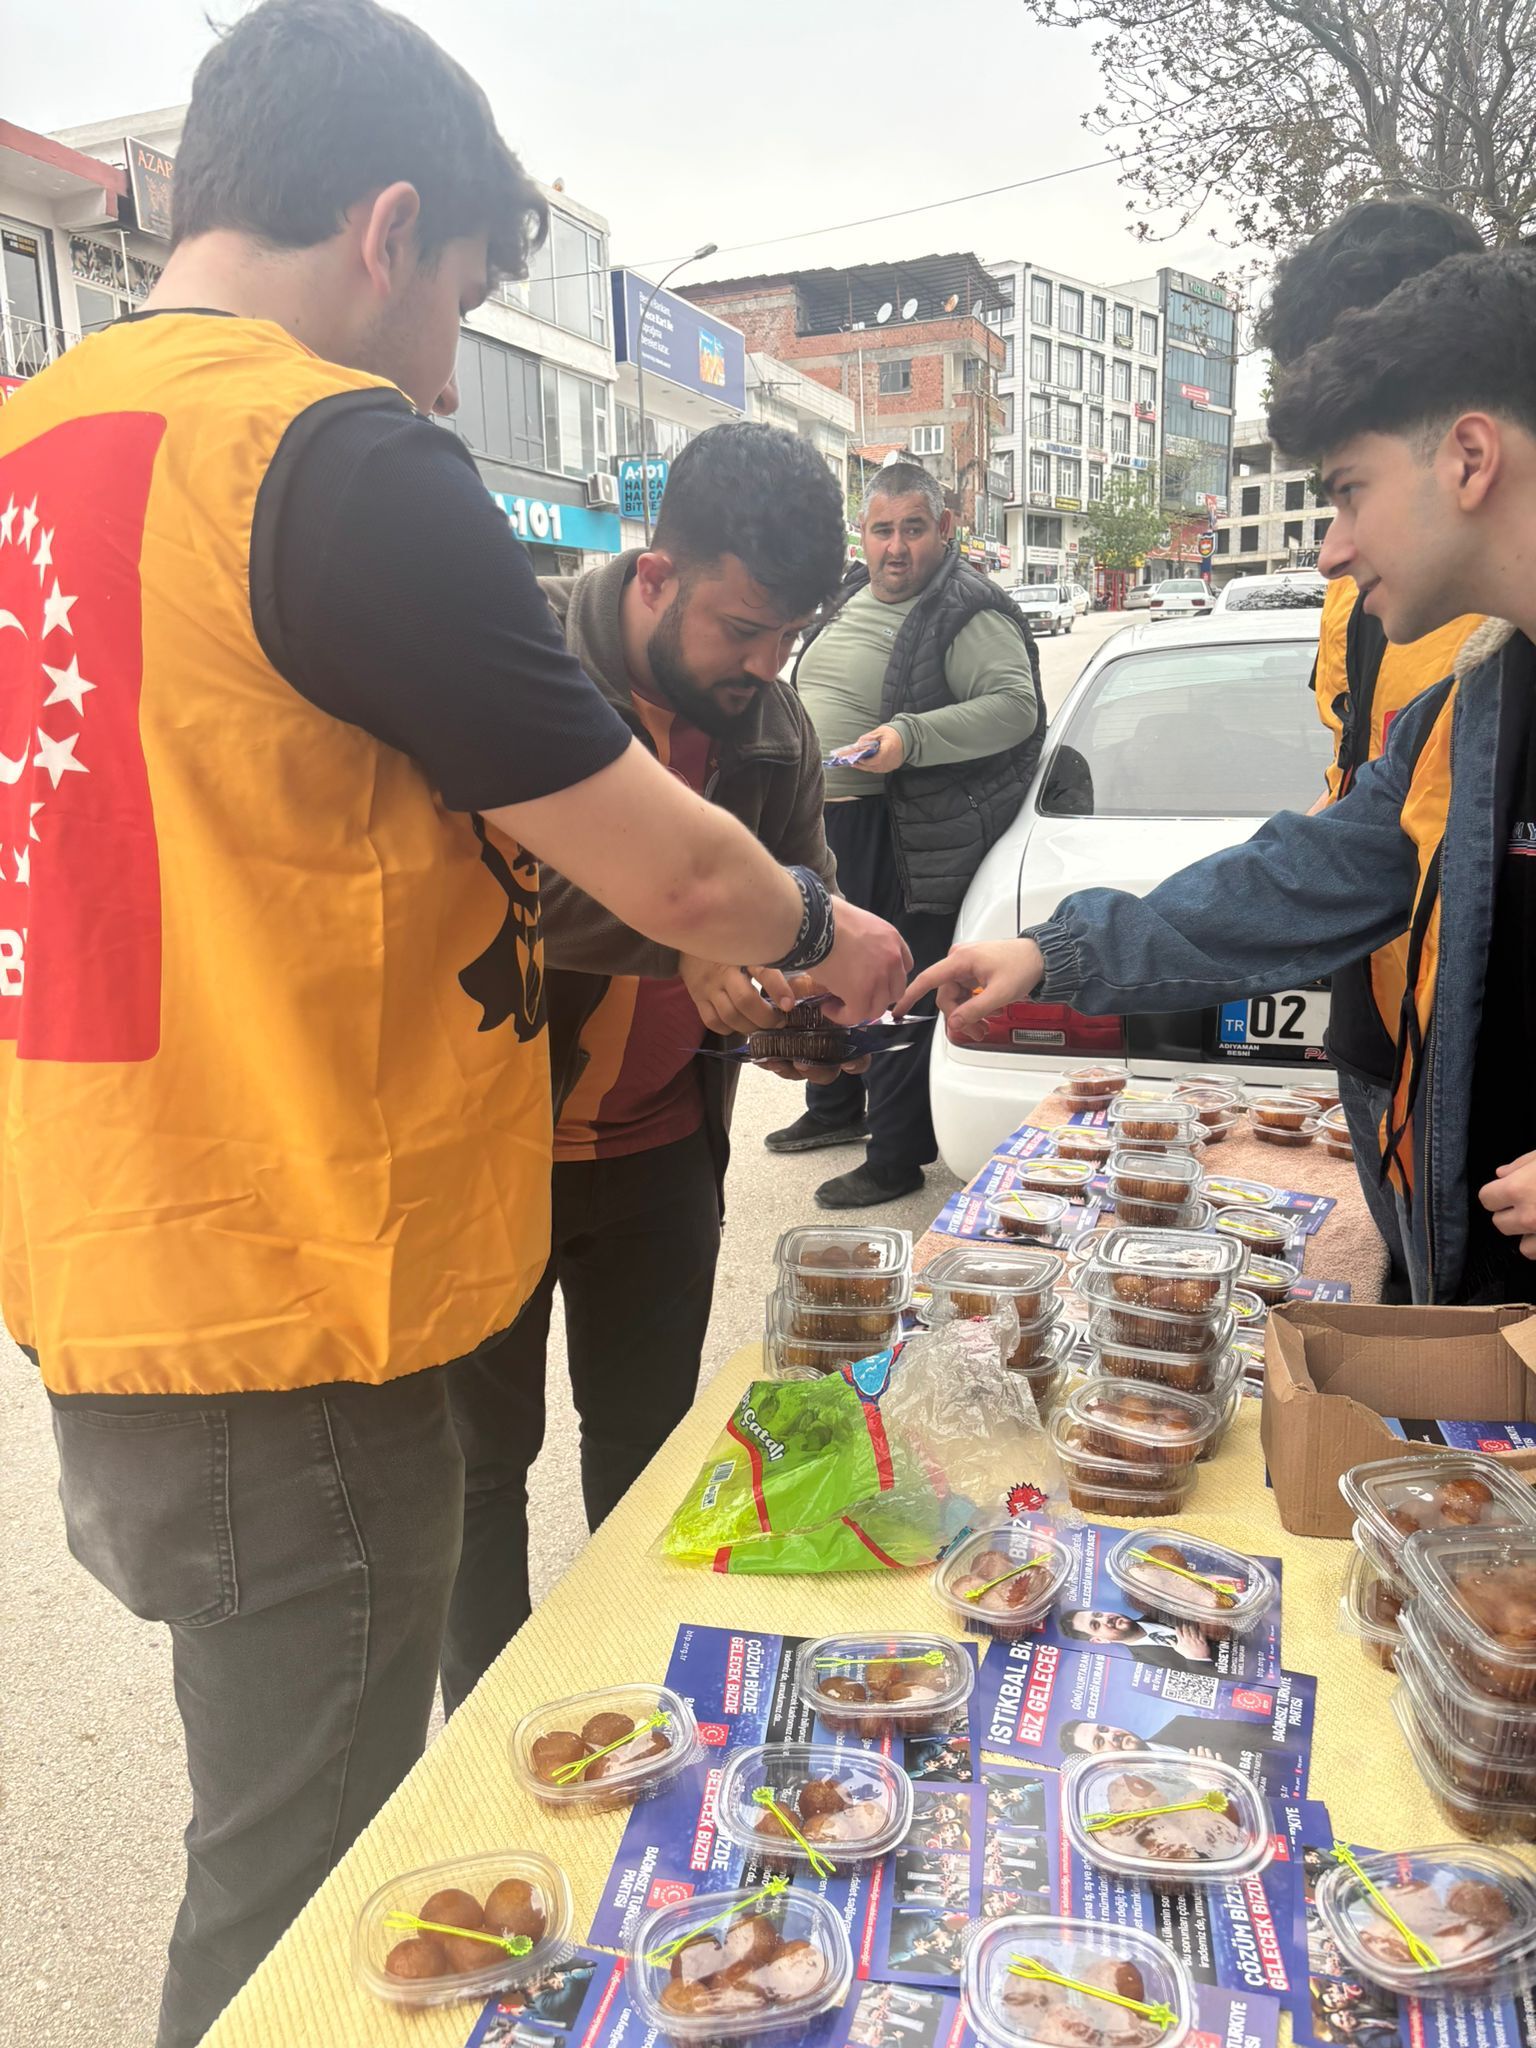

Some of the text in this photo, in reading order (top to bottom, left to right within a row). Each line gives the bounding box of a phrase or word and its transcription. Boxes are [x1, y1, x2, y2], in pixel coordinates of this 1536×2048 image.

[625, 480, 664, 490] HACA
[625, 491, 663, 501] HACA
[625, 501, 661, 512] BİTE
[1225, 1019, 1245, 1032] TR
[1249, 995, 1306, 1040] 02
[1219, 1043, 1260, 1051] ADIYAMAN
[680, 1630, 694, 1661] btp.org.tr
[724, 1637, 744, 1715] GELECEK BİZDE
[742, 1638, 763, 1714] ÇÖZÜM BİZDE
[1020, 1644, 1058, 1742] BİZ GELECEĞ
[690, 1829, 711, 1871] BİZDE
[1232, 1922, 1266, 1986] ÇÖZÜM
[1258, 1916, 1288, 1991] GELECEK
